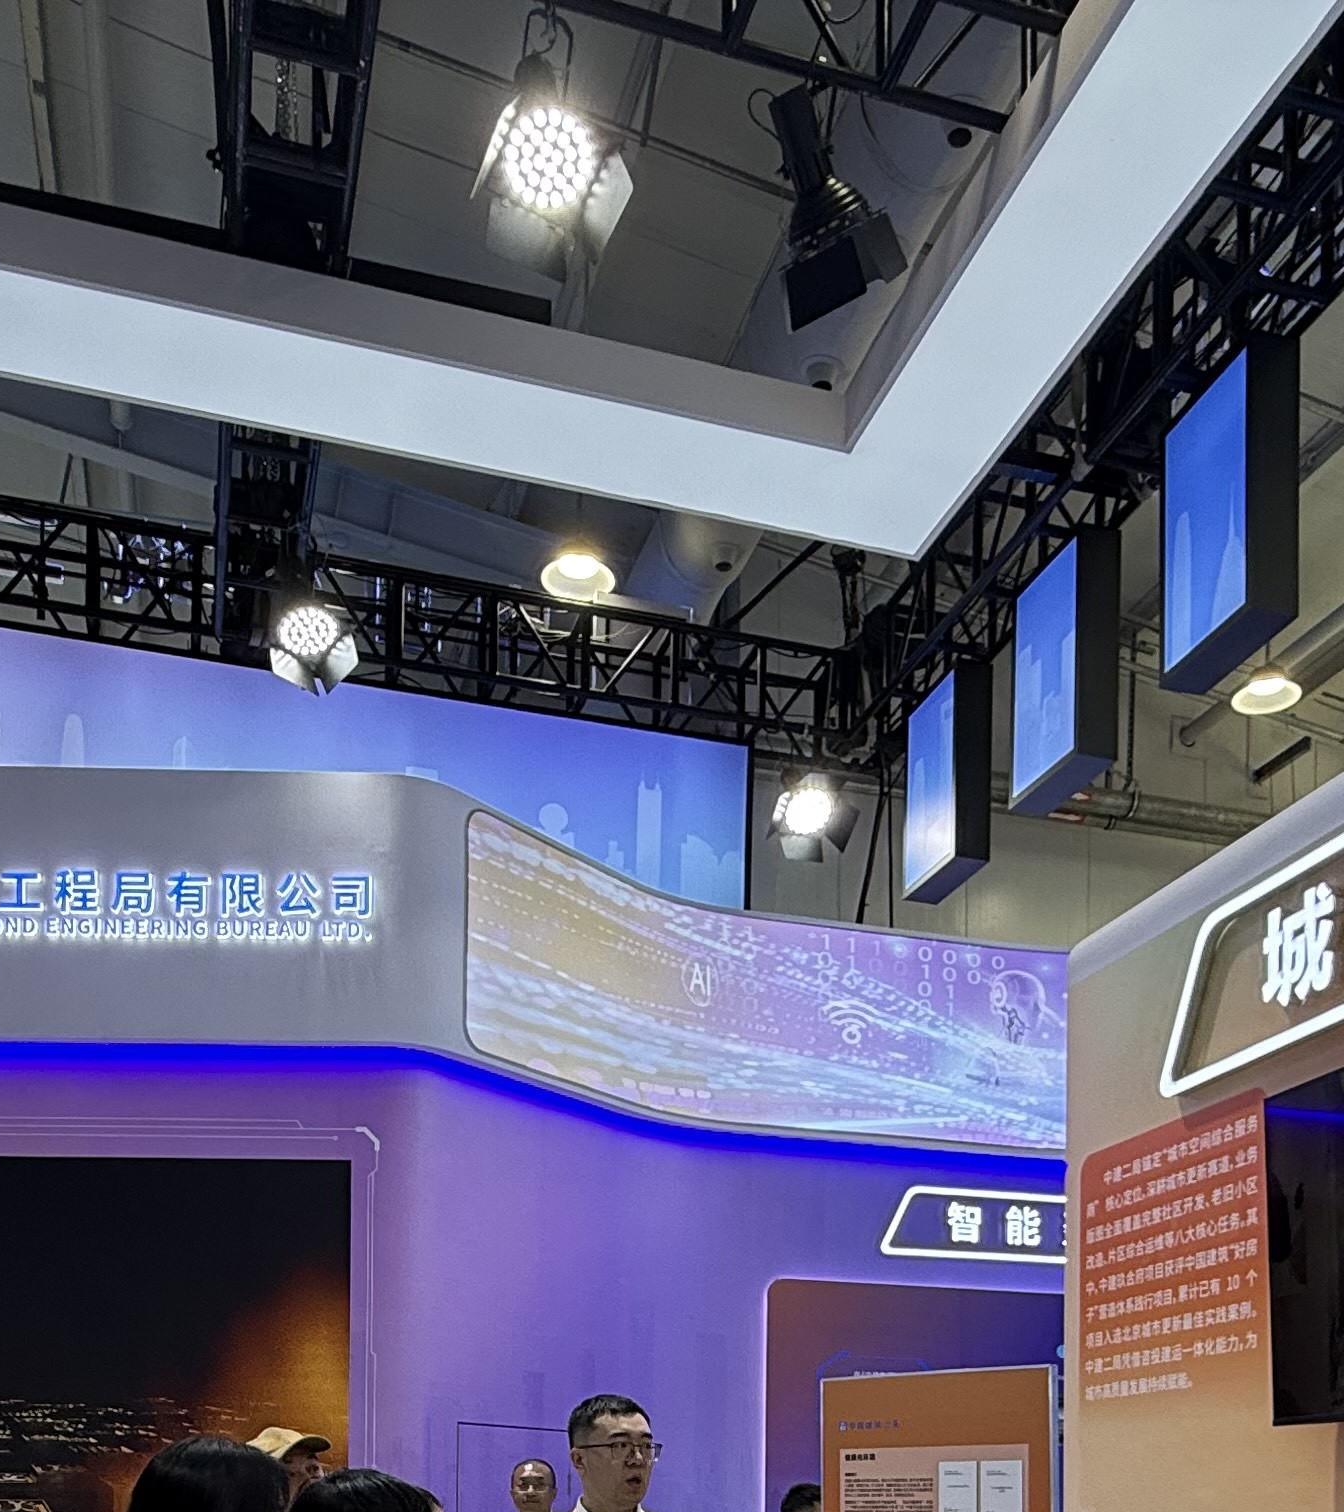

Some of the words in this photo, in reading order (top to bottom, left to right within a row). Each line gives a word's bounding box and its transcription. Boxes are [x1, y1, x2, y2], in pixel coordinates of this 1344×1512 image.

[46, 917, 209, 940] ENGINEERING
[216, 920, 309, 941] BUREAU
[322, 922, 374, 942] LTD.
[689, 961, 712, 997] AI
[1226, 1274, 1241, 1292] 10
[1245, 1268, 1258, 1288] 个
